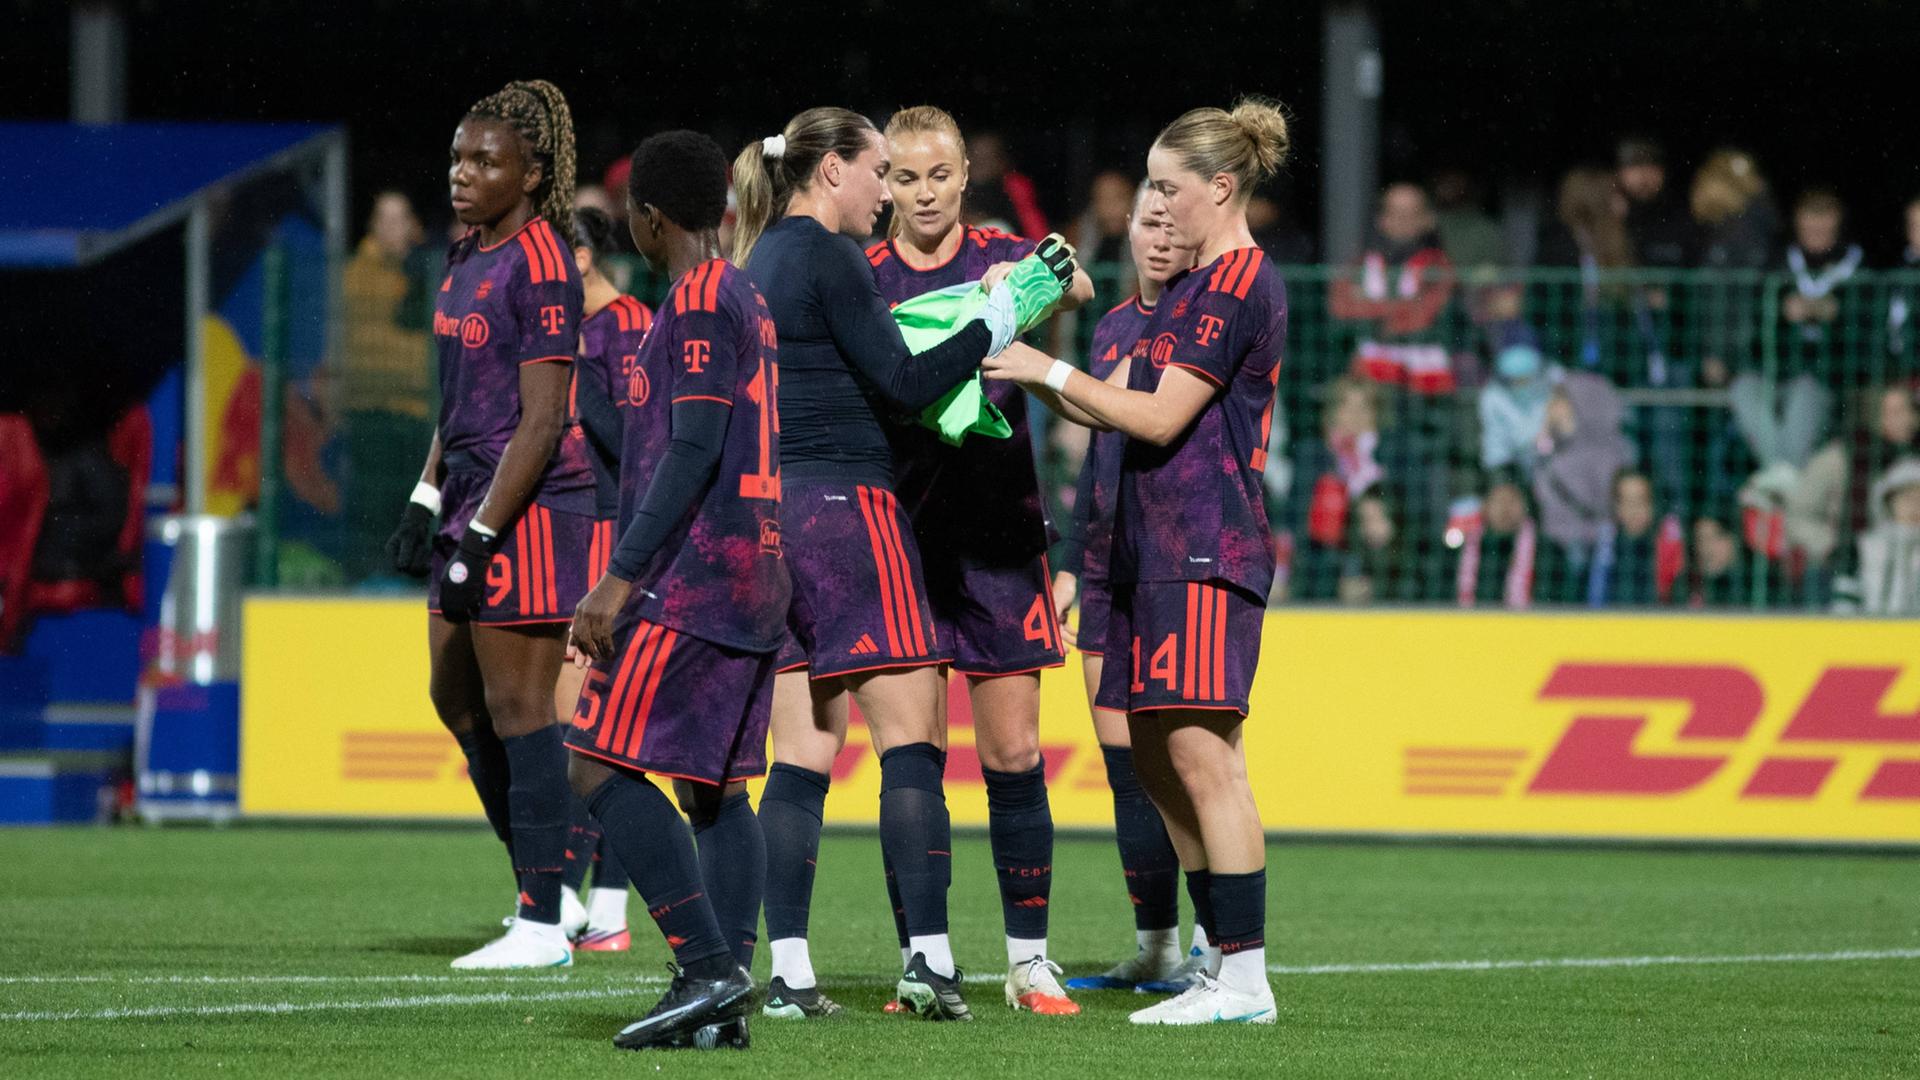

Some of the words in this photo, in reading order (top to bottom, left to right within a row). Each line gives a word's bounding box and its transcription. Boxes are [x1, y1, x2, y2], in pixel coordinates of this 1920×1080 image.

[540, 305, 565, 335] T
[1195, 313, 1225, 347] T
[683, 340, 711, 373] T
[487, 554, 512, 607] 9
[1023, 593, 1053, 650] 4
[1130, 633, 1178, 694] 14
[572, 667, 608, 730] 5
